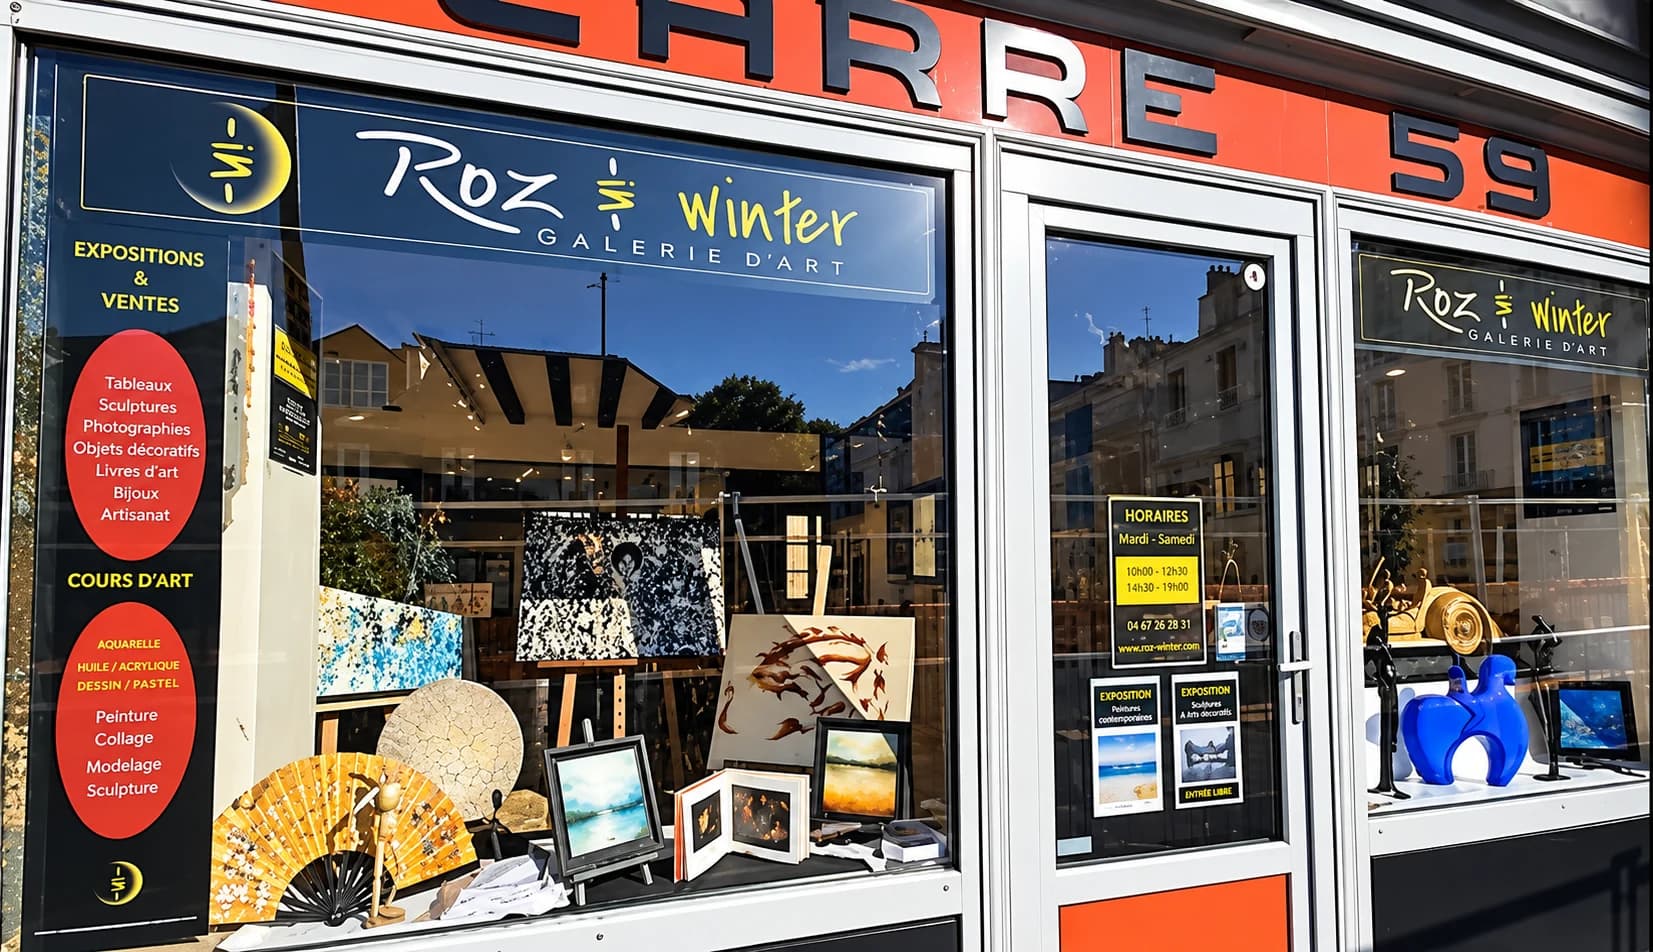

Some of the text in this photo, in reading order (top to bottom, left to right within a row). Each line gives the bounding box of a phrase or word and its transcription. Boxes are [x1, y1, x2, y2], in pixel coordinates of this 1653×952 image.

[1390, 111, 1552, 219] 59
[355, 130, 564, 234] Roz
[74, 241, 205, 268] EXPOSITIONS
[537, 228, 844, 275] GALERIE D'ART
[134, 270, 148, 286] &
[101, 292, 180, 313] VENTES
[1390, 268, 1481, 333] Roz
[1468, 329, 1607, 357] GALERIE D'ART
[104, 376, 172, 392] Tableaux
[98, 398, 177, 415] Sculptures
[83, 419, 191, 437] Photographies
[73, 441, 200, 458] Objets décoratifs
[96, 463, 179, 478] Livres d'art
[113, 486, 159, 502] Bijoux
[101, 507, 170, 521] Artisanat
[1125, 509, 1189, 522] HORAIRES
[1119, 532, 1149, 545] Mardi
[1158, 533, 1195, 545] Samedi
[1127, 566, 1154, 577] 10h00
[1162, 566, 1188, 577] 12h30
[67, 573, 194, 588] COURS D'ART
[1127, 582, 1154, 592] 14h30
[1163, 582, 1189, 592] 19h00
[1127, 619, 1191, 632] 04 67 26 28 31
[97, 639, 161, 650] AQUARELLE
[1118, 641, 1200, 654] www.roz-winter.com
[77, 661, 180, 673] HUILE / ACRYLIQUE
[77, 678, 180, 691] DESSIN / PASTEL
[1181, 685, 1231, 697] EXPOSITION
[1100, 689, 1152, 701] EXPOSITION
[95, 710, 158, 724] Peinture
[95, 731, 154, 748] Collage
[86, 757, 162, 774] Modelage
[87, 782, 159, 798] Sculpture
[1212, 787, 1233, 797] LIBRE
